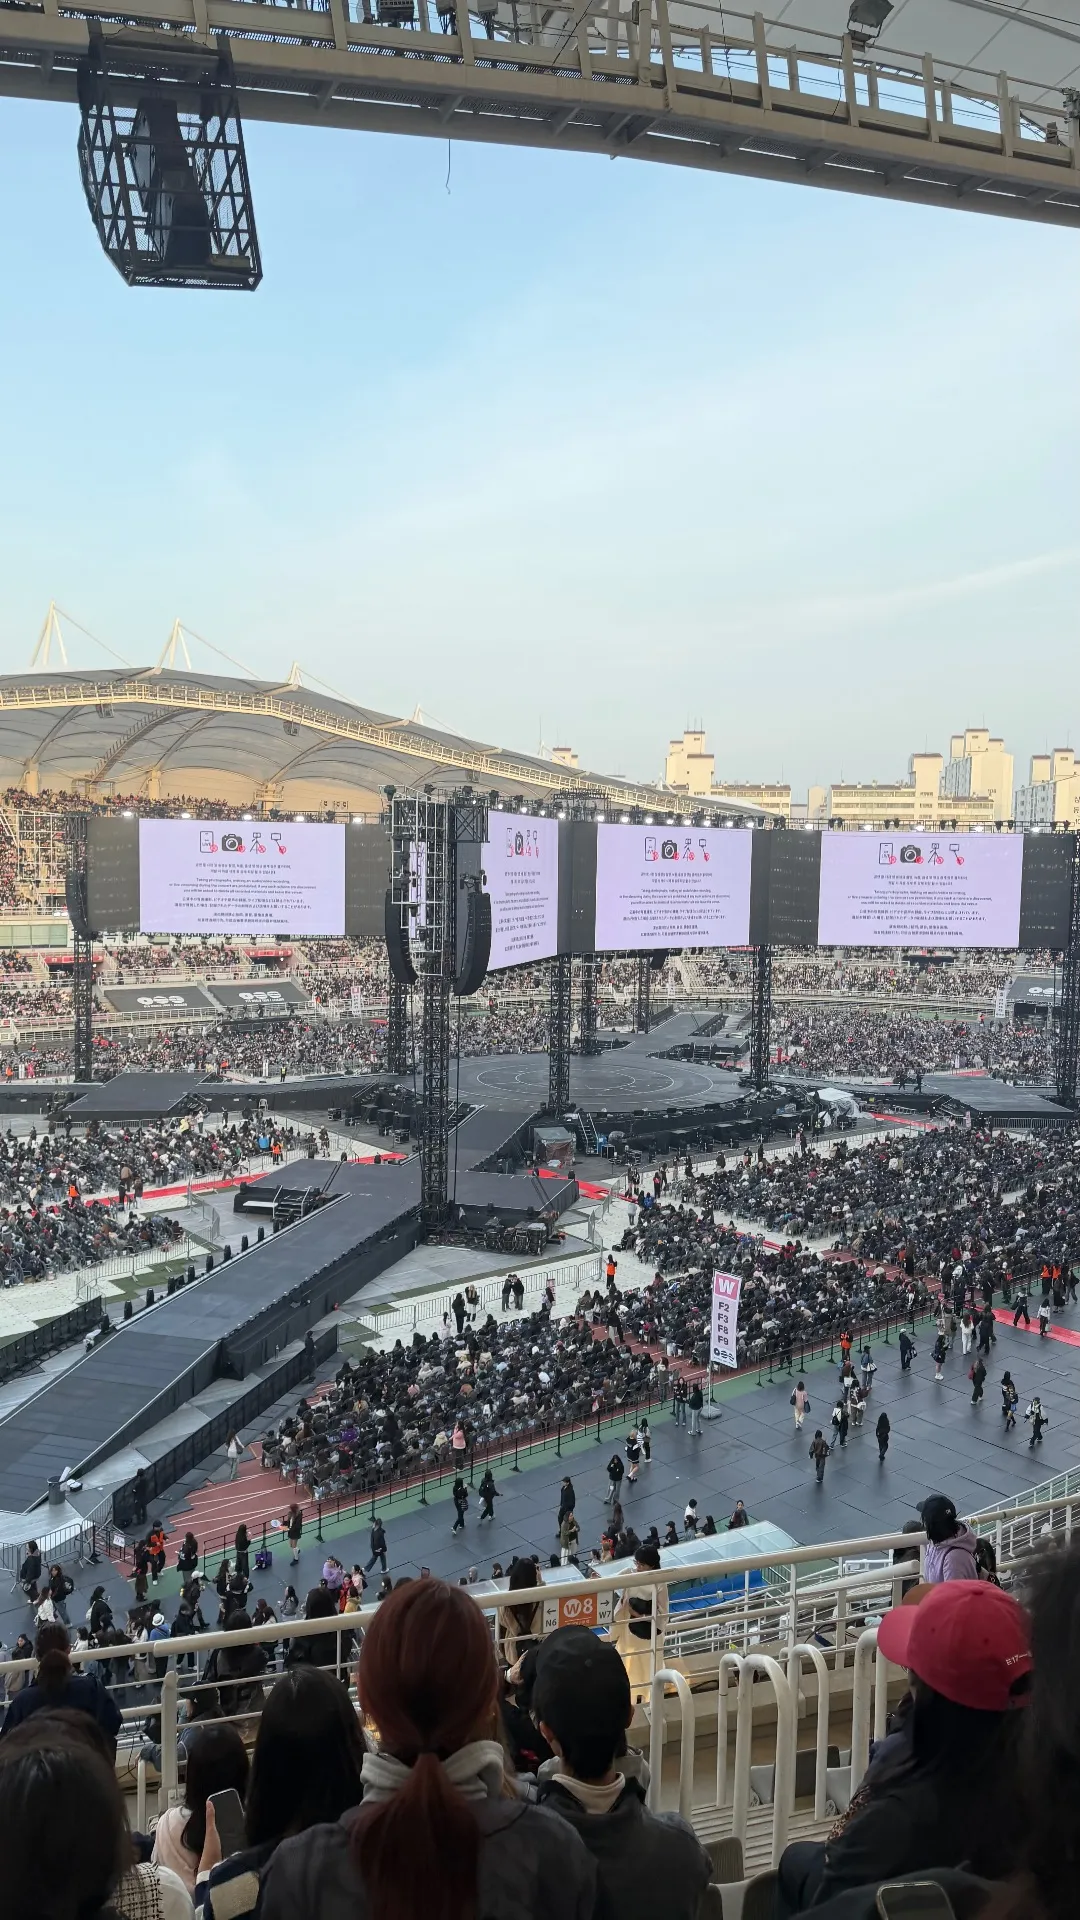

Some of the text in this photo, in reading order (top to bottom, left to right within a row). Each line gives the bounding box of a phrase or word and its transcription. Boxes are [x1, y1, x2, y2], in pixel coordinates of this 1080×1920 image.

[718, 1277, 736, 1295] W
[718, 1301, 730, 1313] F2
[717, 1312, 729, 1324] F3
[717, 1323, 729, 1335] F8
[717, 1335, 729, 1346] F9
[599, 1610, 612, 1619] W7
[545, 1618, 557, 1627] N6
